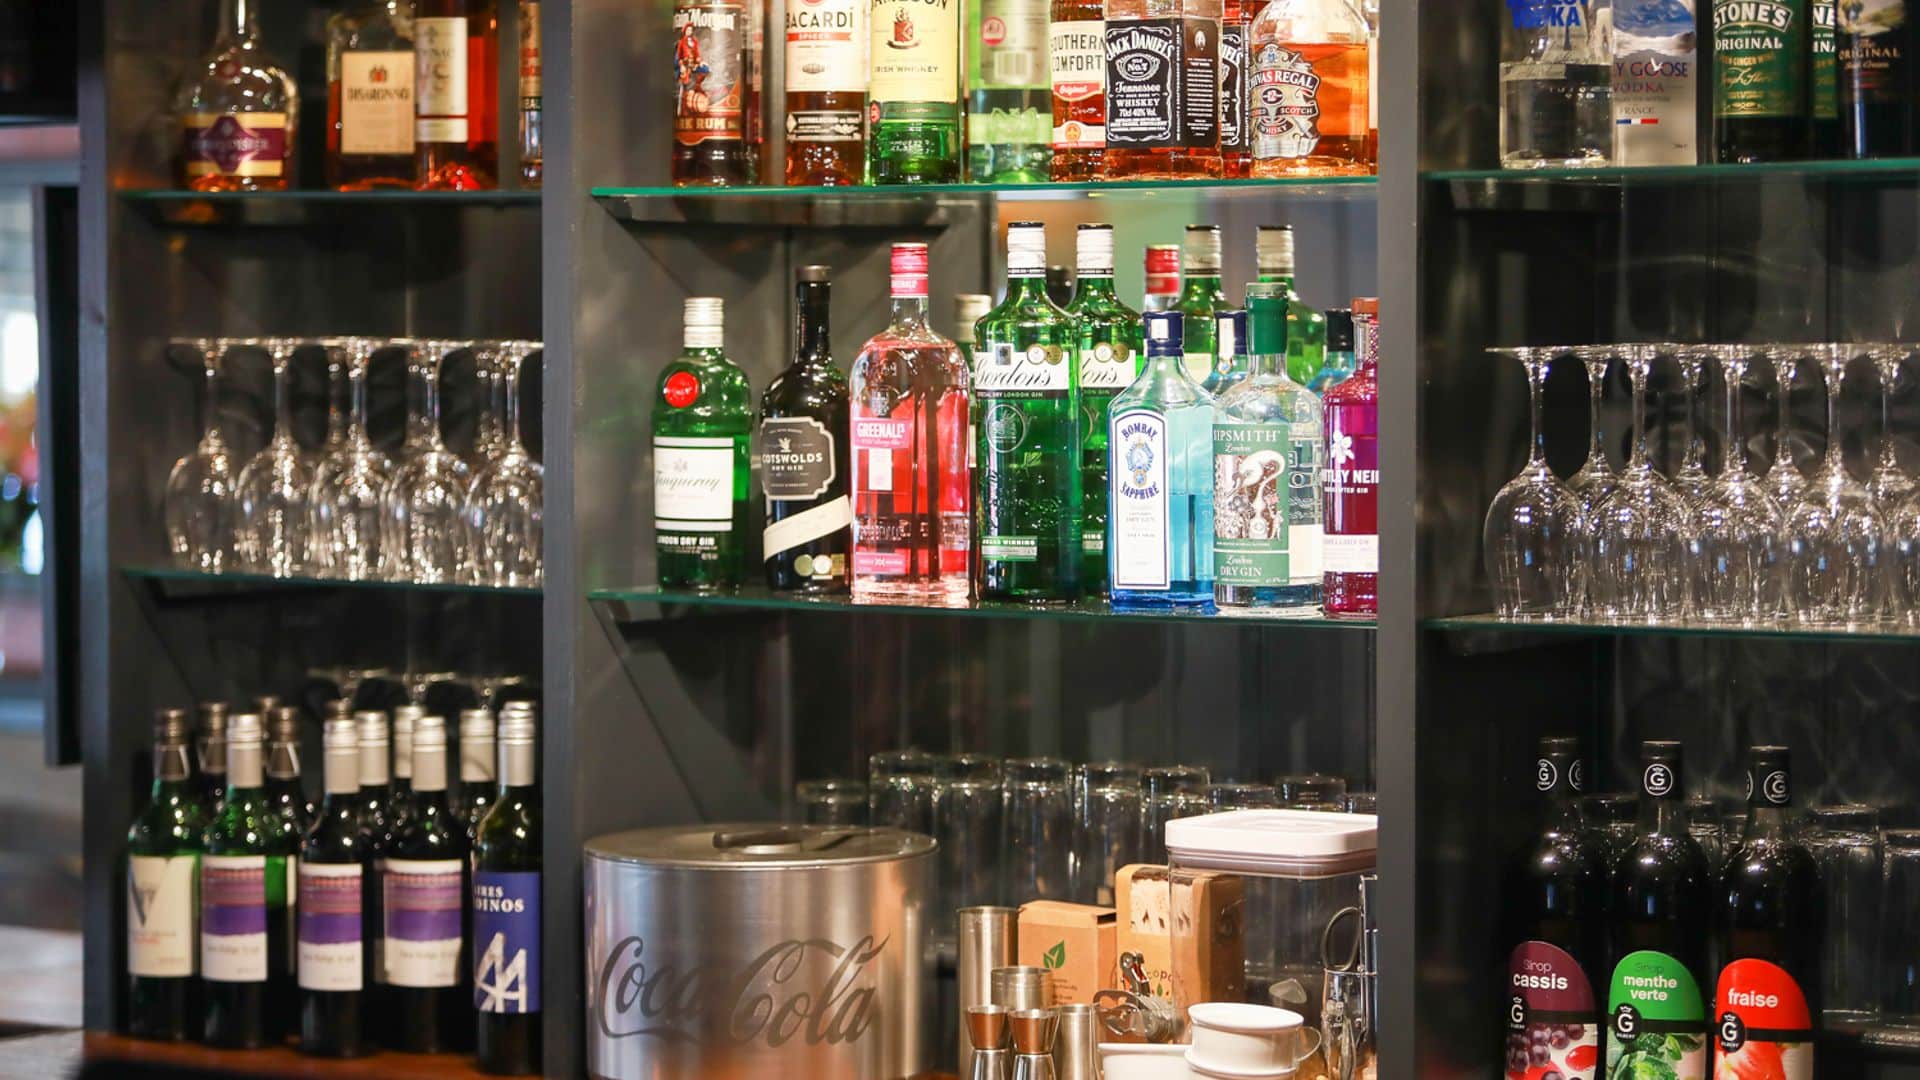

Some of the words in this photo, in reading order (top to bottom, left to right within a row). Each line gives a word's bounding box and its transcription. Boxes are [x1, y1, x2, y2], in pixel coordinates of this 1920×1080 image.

[1713, 3, 1787, 29] STONE'S
[1106, 36, 1131, 61] JACK
[1131, 30, 1175, 60] DANIEL'S
[1714, 37, 1784, 51] ORIGINAL
[1838, 49, 1901, 61] ORIGINAL
[1630, 61, 1688, 78] GOOSE
[1115, 80, 1161, 93] Tennessee
[1274, 70, 1315, 89] REGAL
[1116, 98, 1160, 107] WHISKEY
[1280, 105, 1314, 115] SCOTCH
[696, 117, 726, 130] RUM
[975, 358, 1051, 387] Gordon's
[1121, 422, 1158, 438] BOMBAY
[762, 452, 823, 464] COTSWOLDS
[1352, 470, 1379, 484] NEI
[1120, 481, 1159, 499] SAPPHIRE
[680, 536, 697, 546] DRY
[699, 536, 715, 546] GIN
[1220, 565, 1238, 576] DRY
[1240, 567, 1262, 577] GIN
[475, 898, 525, 913] DINOS
[1524, 959, 1552, 974] Sirop
[1513, 972, 1568, 990] cassis
[1624, 975, 1677, 989] menthe
[1630, 989, 1668, 1001] verte
[1728, 987, 1778, 1009] fraise
[1511, 1004, 1524, 1024] G
[1617, 1013, 1634, 1033] G
[1722, 1021, 1737, 1042] G
